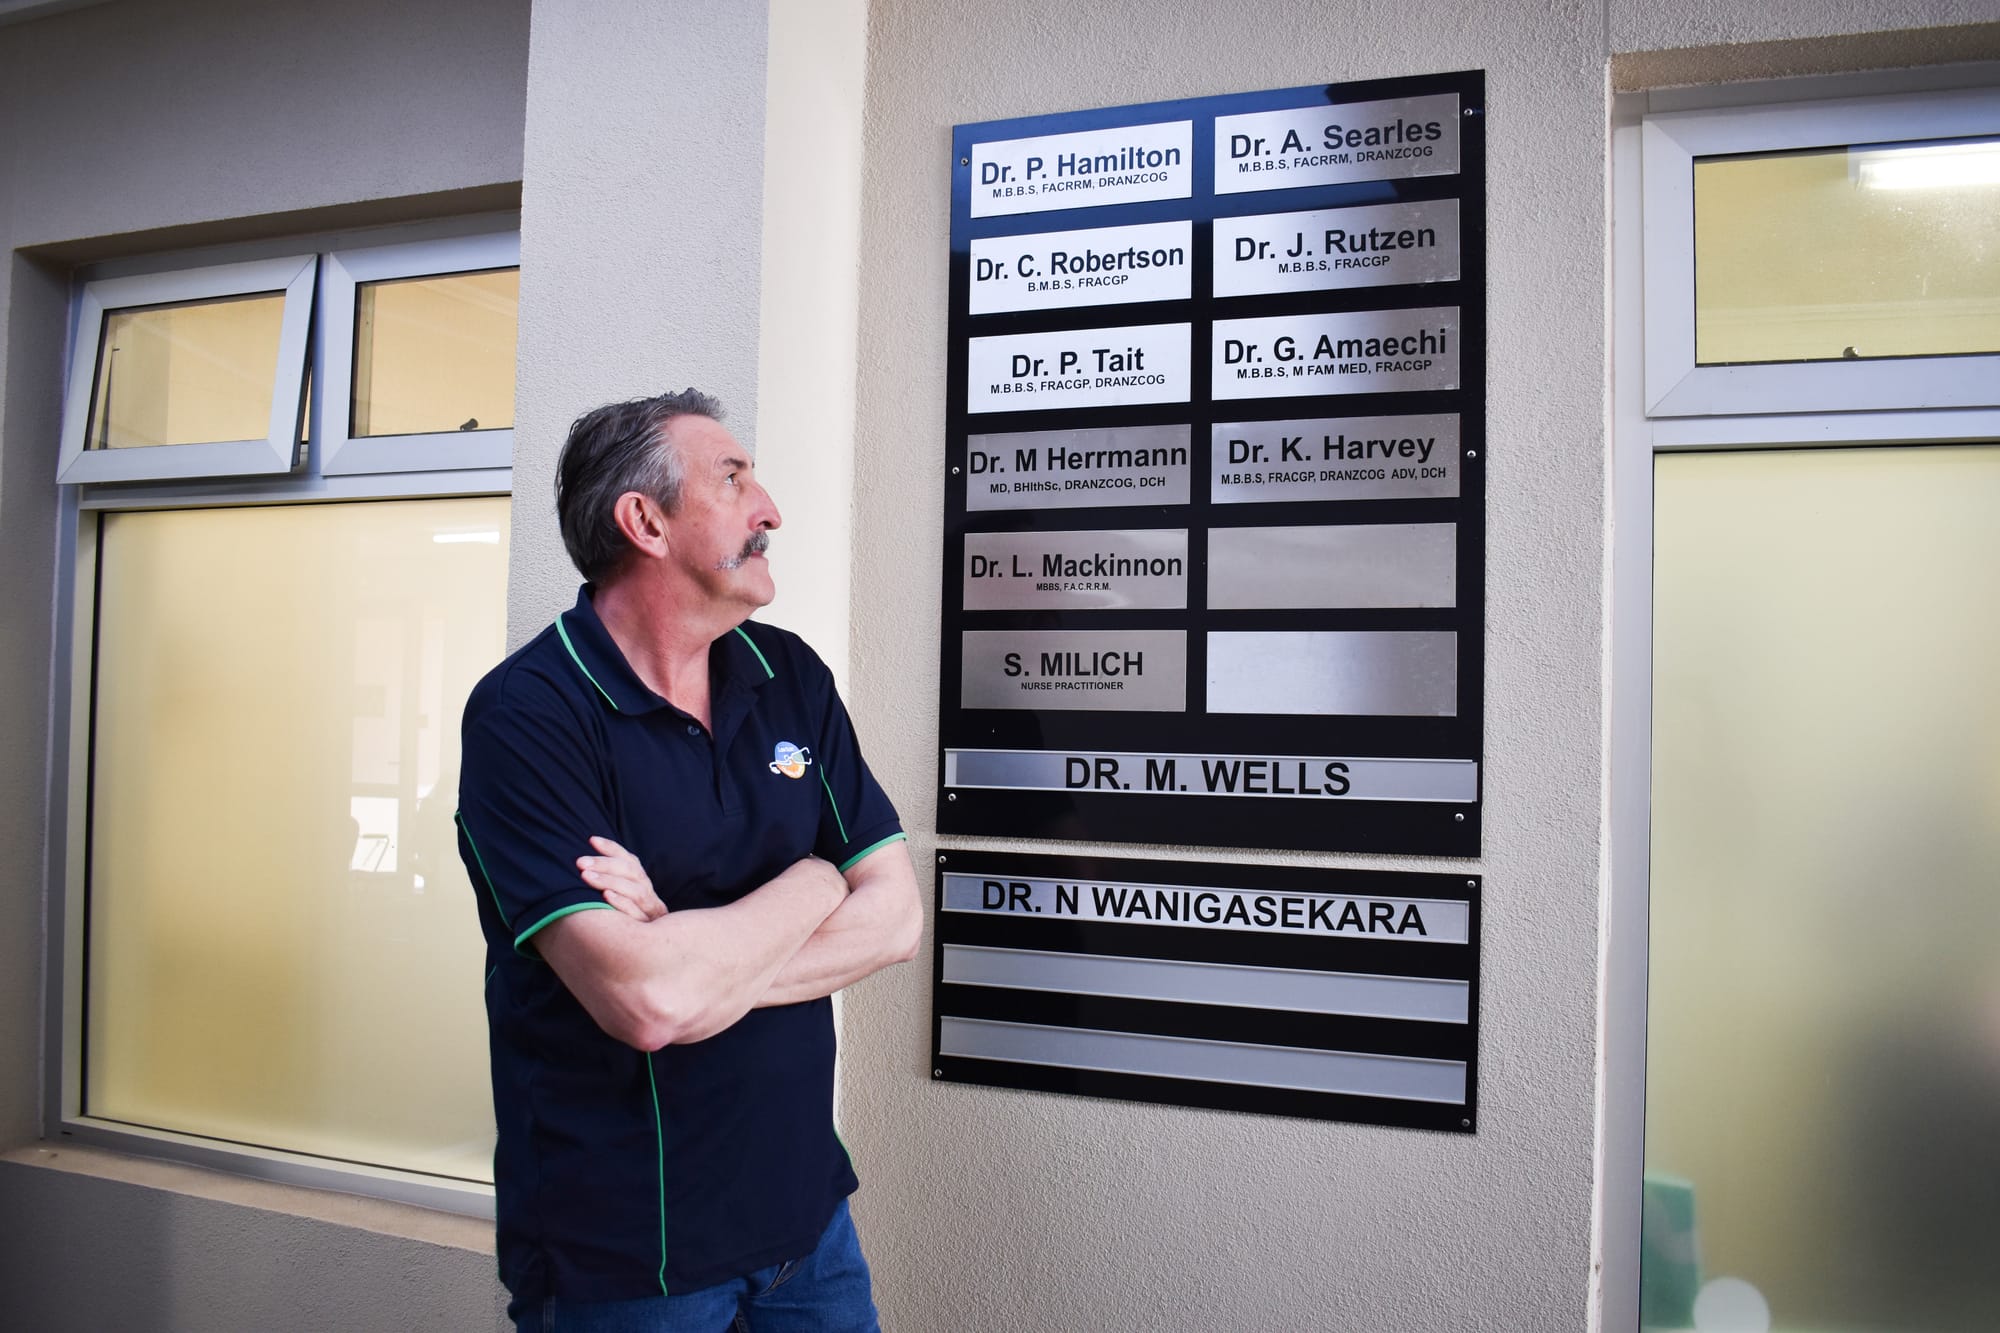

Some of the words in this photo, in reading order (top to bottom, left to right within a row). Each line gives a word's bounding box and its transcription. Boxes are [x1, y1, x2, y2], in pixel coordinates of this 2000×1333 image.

[1231, 134, 1270, 159] Dr.
[1280, 129, 1311, 154] A.
[1324, 119, 1442, 149] Searles
[982, 162, 1016, 185] Dr.
[1027, 157, 1047, 180] P.
[1058, 147, 1180, 177] Hamilton
[1239, 159, 1290, 173] M.B.B.S,
[1294, 153, 1352, 168] FACRRM,
[1357, 145, 1433, 162] DRANZCOG
[993, 185, 1038, 198] M.B.B.S,
[1042, 179, 1095, 193] FACRRM,
[1099, 171, 1168, 187] DRANZCOG
[1235, 237, 1275, 261] Dr.
[1287, 232, 1312, 257] J.
[1325, 227, 1435, 254] Rutzen
[977, 258, 1008, 281] Dr.
[1017, 254, 1041, 278] C.
[1051, 247, 1183, 275] Robertson
[1279, 260, 1331, 273] M.B.B.S,
[1335, 255, 1391, 269] FRACGP
[1078, 275, 1128, 288] FRACGP
[1225, 340, 1262, 364] Dr.
[1274, 336, 1304, 361] G.
[1313, 328, 1446, 359] Amaechi
[1012, 354, 1048, 378] Dr.
[1060, 351, 1081, 375] P.
[1092, 347, 1144, 373] Tait
[1237, 367, 1288, 379] M.B.B.S,
[1293, 366, 1303, 376] M
[1307, 364, 1334, 376] FAM
[1339, 363, 1371, 375] MED,
[1376, 359, 1432, 372] FRACGP
[991, 382, 1037, 394] M.B.B.S,
[1041, 379, 1091, 391] FRACGP,
[1095, 374, 1165, 388] DRANZCOG
[970, 451, 1004, 474] Dr.
[1016, 448, 1037, 472] M
[1048, 447, 1186, 471] Herrmann
[1229, 440, 1269, 464] Dr.
[1282, 437, 1311, 462] K.
[1324, 435, 1435, 464] Harvey
[990, 483, 1010, 494] MD,
[1065, 478, 1136, 490] DRANZCOG,
[1140, 476, 1165, 487] DCH
[1221, 473, 1265, 485] M.B.B.S,
[1268, 471, 1316, 483] FRACGP,
[1320, 469, 1385, 481] DRANZCOG
[1391, 468, 1418, 480] ADV,
[1421, 467, 1446, 479] DCH
[971, 555, 1002, 578] Dr.
[1012, 554, 1033, 577] L.
[1042, 553, 1182, 577] Mackinnon
[1036, 582, 1062, 592] MBBS,
[1004, 653, 1029, 677] S.
[1041, 652, 1142, 676] MILICH
[1021, 682, 1052, 690] NURSE
[1055, 681, 1124, 690] PRACTITIONER
[1065, 757, 1130, 790] DR.
[1146, 759, 1187, 791] M.
[1201, 760, 1350, 796] WELLS
[982, 880, 1041, 912] DR.
[1056, 886, 1078, 915] N
[1092, 887, 1427, 936] WANIGASEKARA
